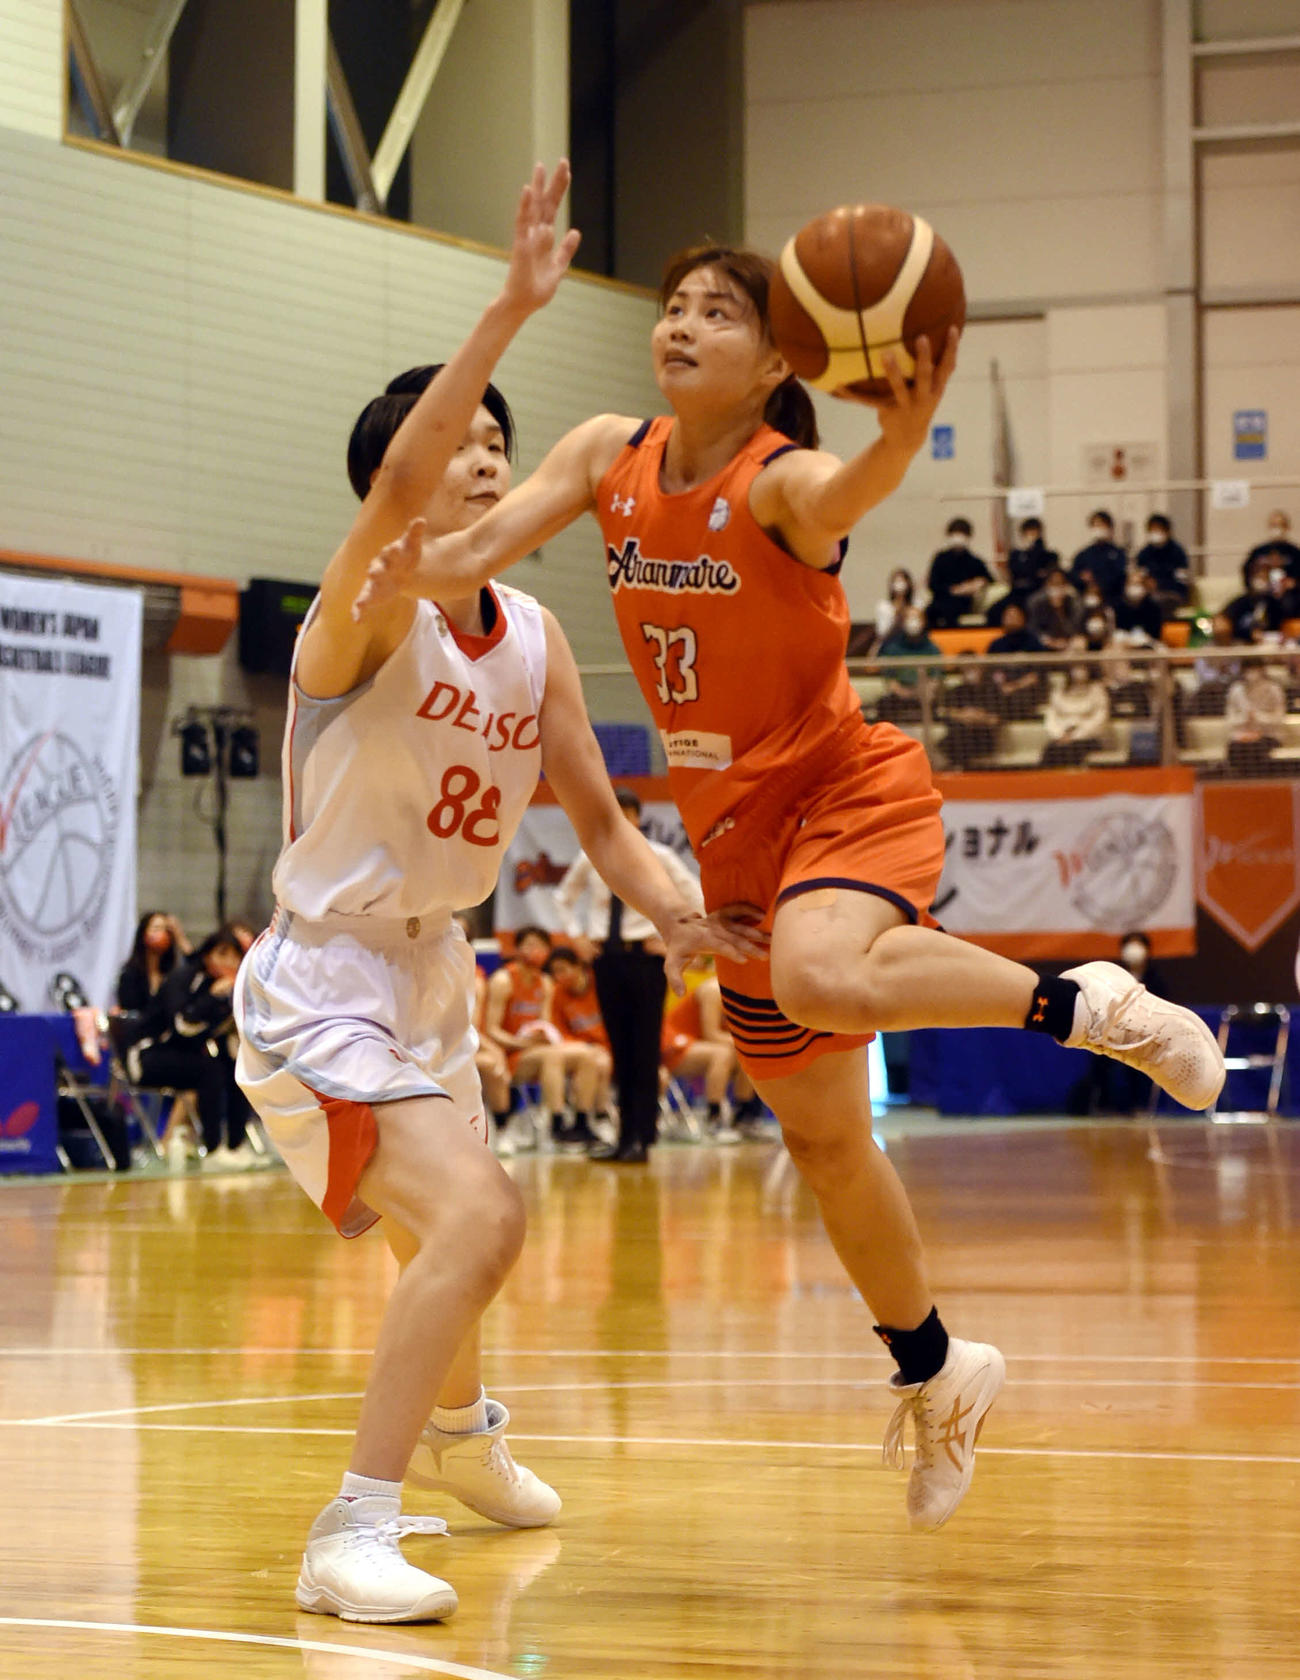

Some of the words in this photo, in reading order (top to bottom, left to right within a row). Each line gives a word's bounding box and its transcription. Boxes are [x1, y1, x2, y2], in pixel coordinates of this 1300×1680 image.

[608, 537, 742, 595] Aranmare
[641, 622, 700, 705] 33
[427, 765, 501, 847] 88
[943, 818, 1040, 859] ョナル
